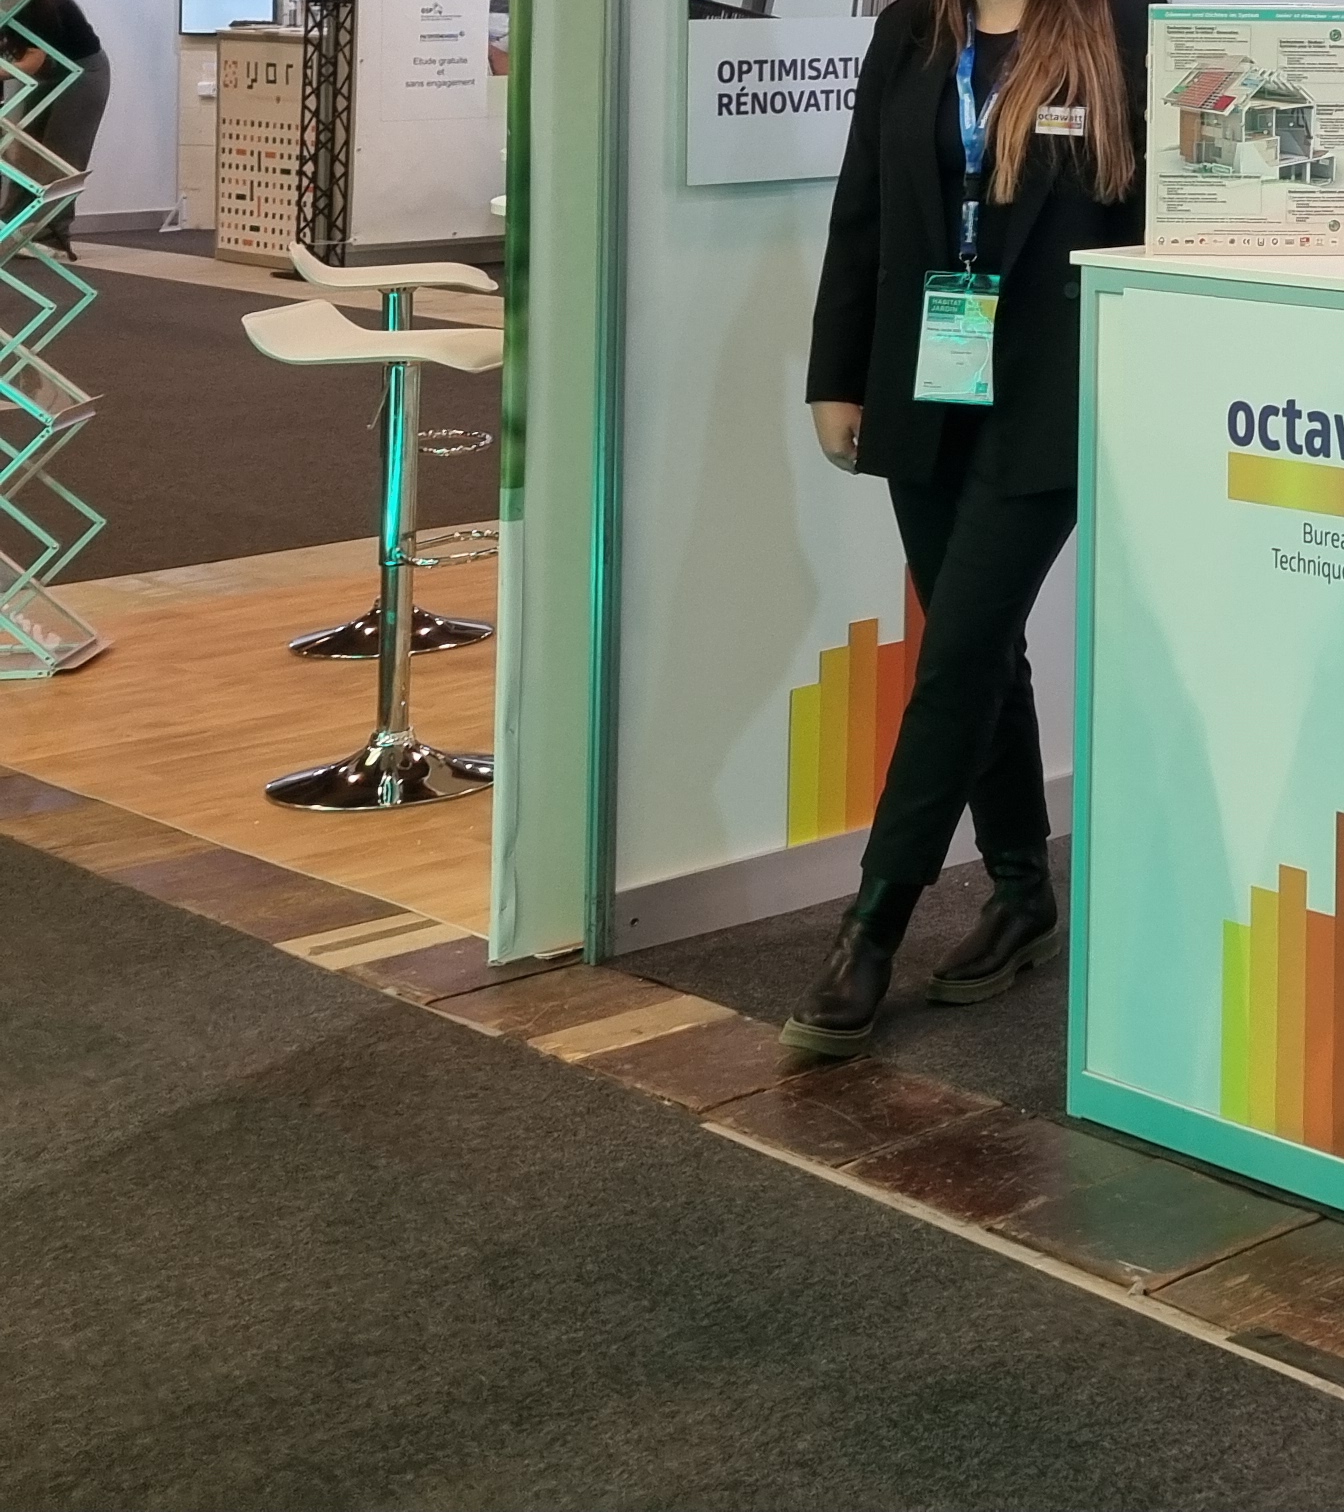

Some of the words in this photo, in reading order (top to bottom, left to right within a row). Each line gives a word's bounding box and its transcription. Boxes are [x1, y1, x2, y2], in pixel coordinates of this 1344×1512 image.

[413, 57, 437, 66] Etude
[438, 57, 468, 67] gratuite
[436, 68, 445, 76] et
[716, 56, 860, 84] OPTIMISATI
[405, 80, 424, 88] sans
[426, 78, 476, 89] engagement
[716, 86, 857, 116] RÉNOVATIO
